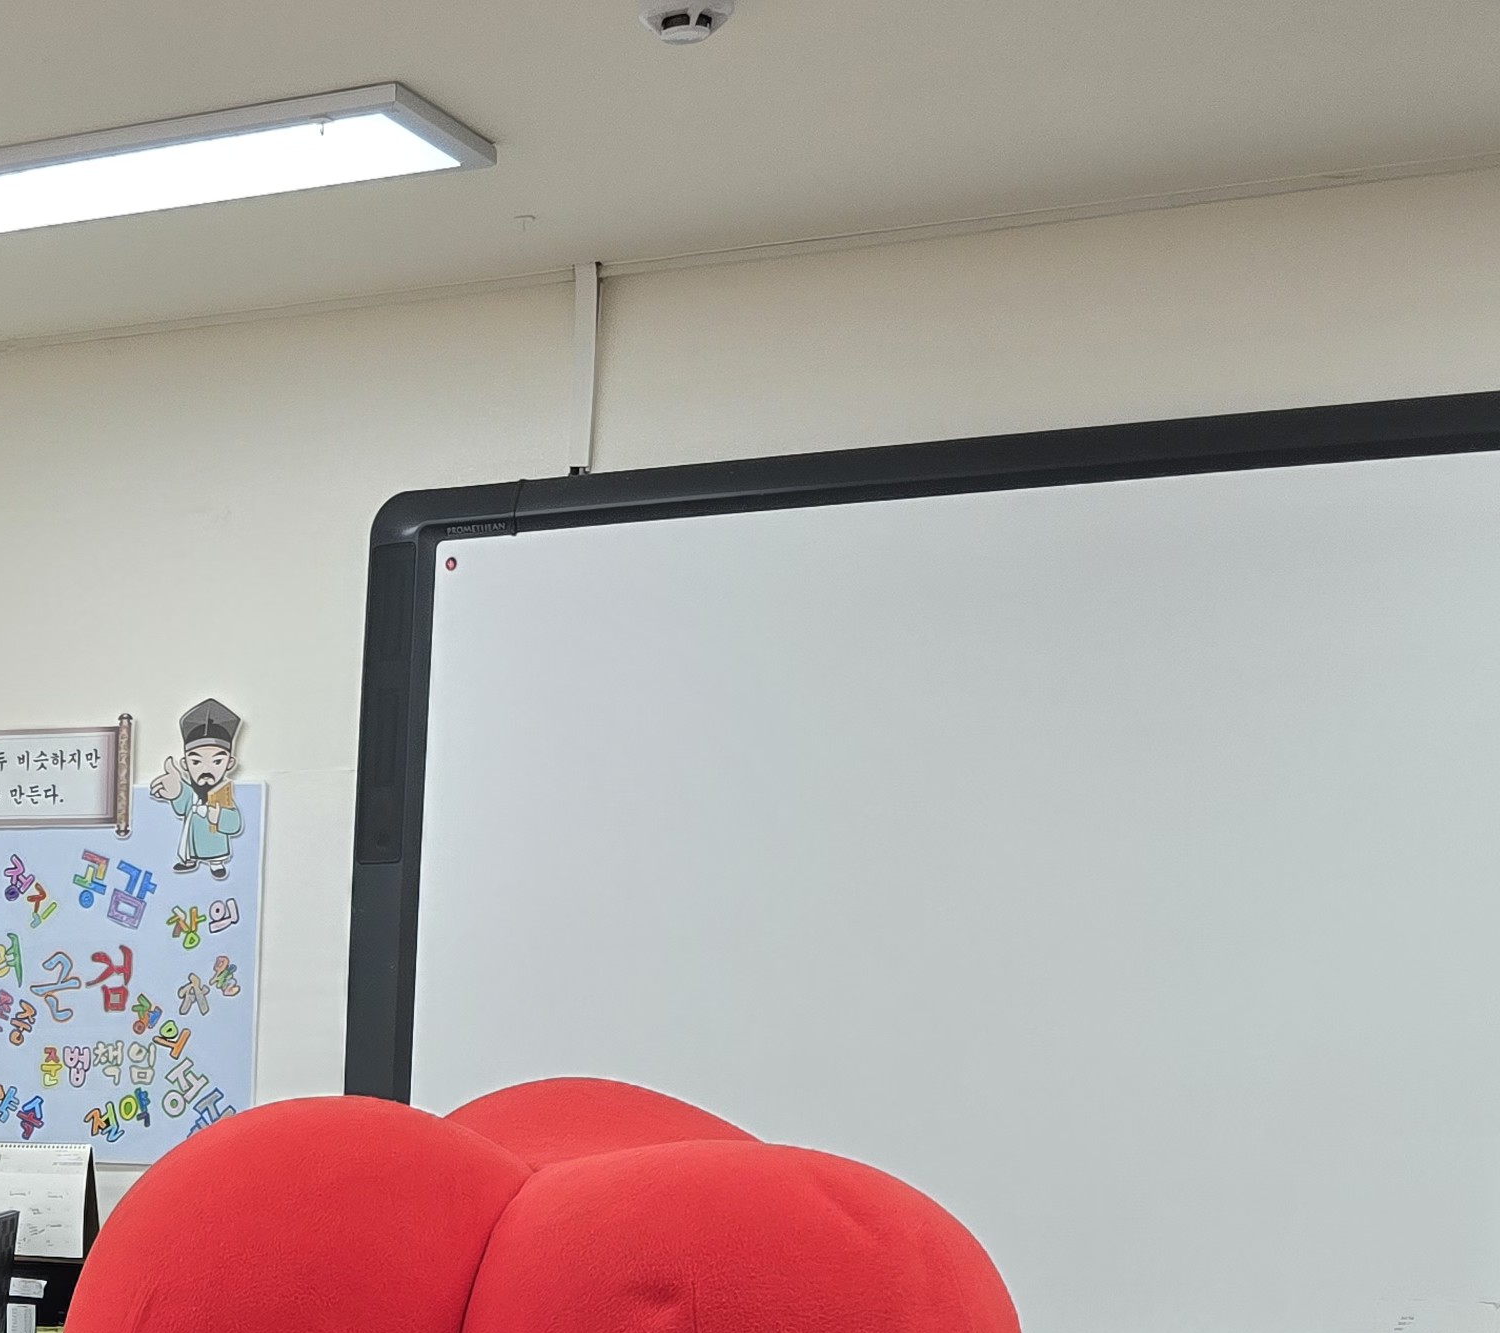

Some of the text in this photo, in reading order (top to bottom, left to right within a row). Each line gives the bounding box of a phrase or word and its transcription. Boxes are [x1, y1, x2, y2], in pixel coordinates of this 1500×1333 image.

[17, 748, 101, 771] 비슷하지만
[10, 784, 65, 805] 만든다.
[3, 854, 58, 929] 정직
[72, 849, 157, 930] 공감
[165, 897, 240, 949] 창의
[30, 944, 134, 1022] 근검
[177, 955, 241, 1016] 자율
[131, 993, 191, 1060] 정의
[40, 1045, 91, 1088] 준법
[92, 1040, 156, 1086] 책임
[84, 1087, 151, 1143] 절약
